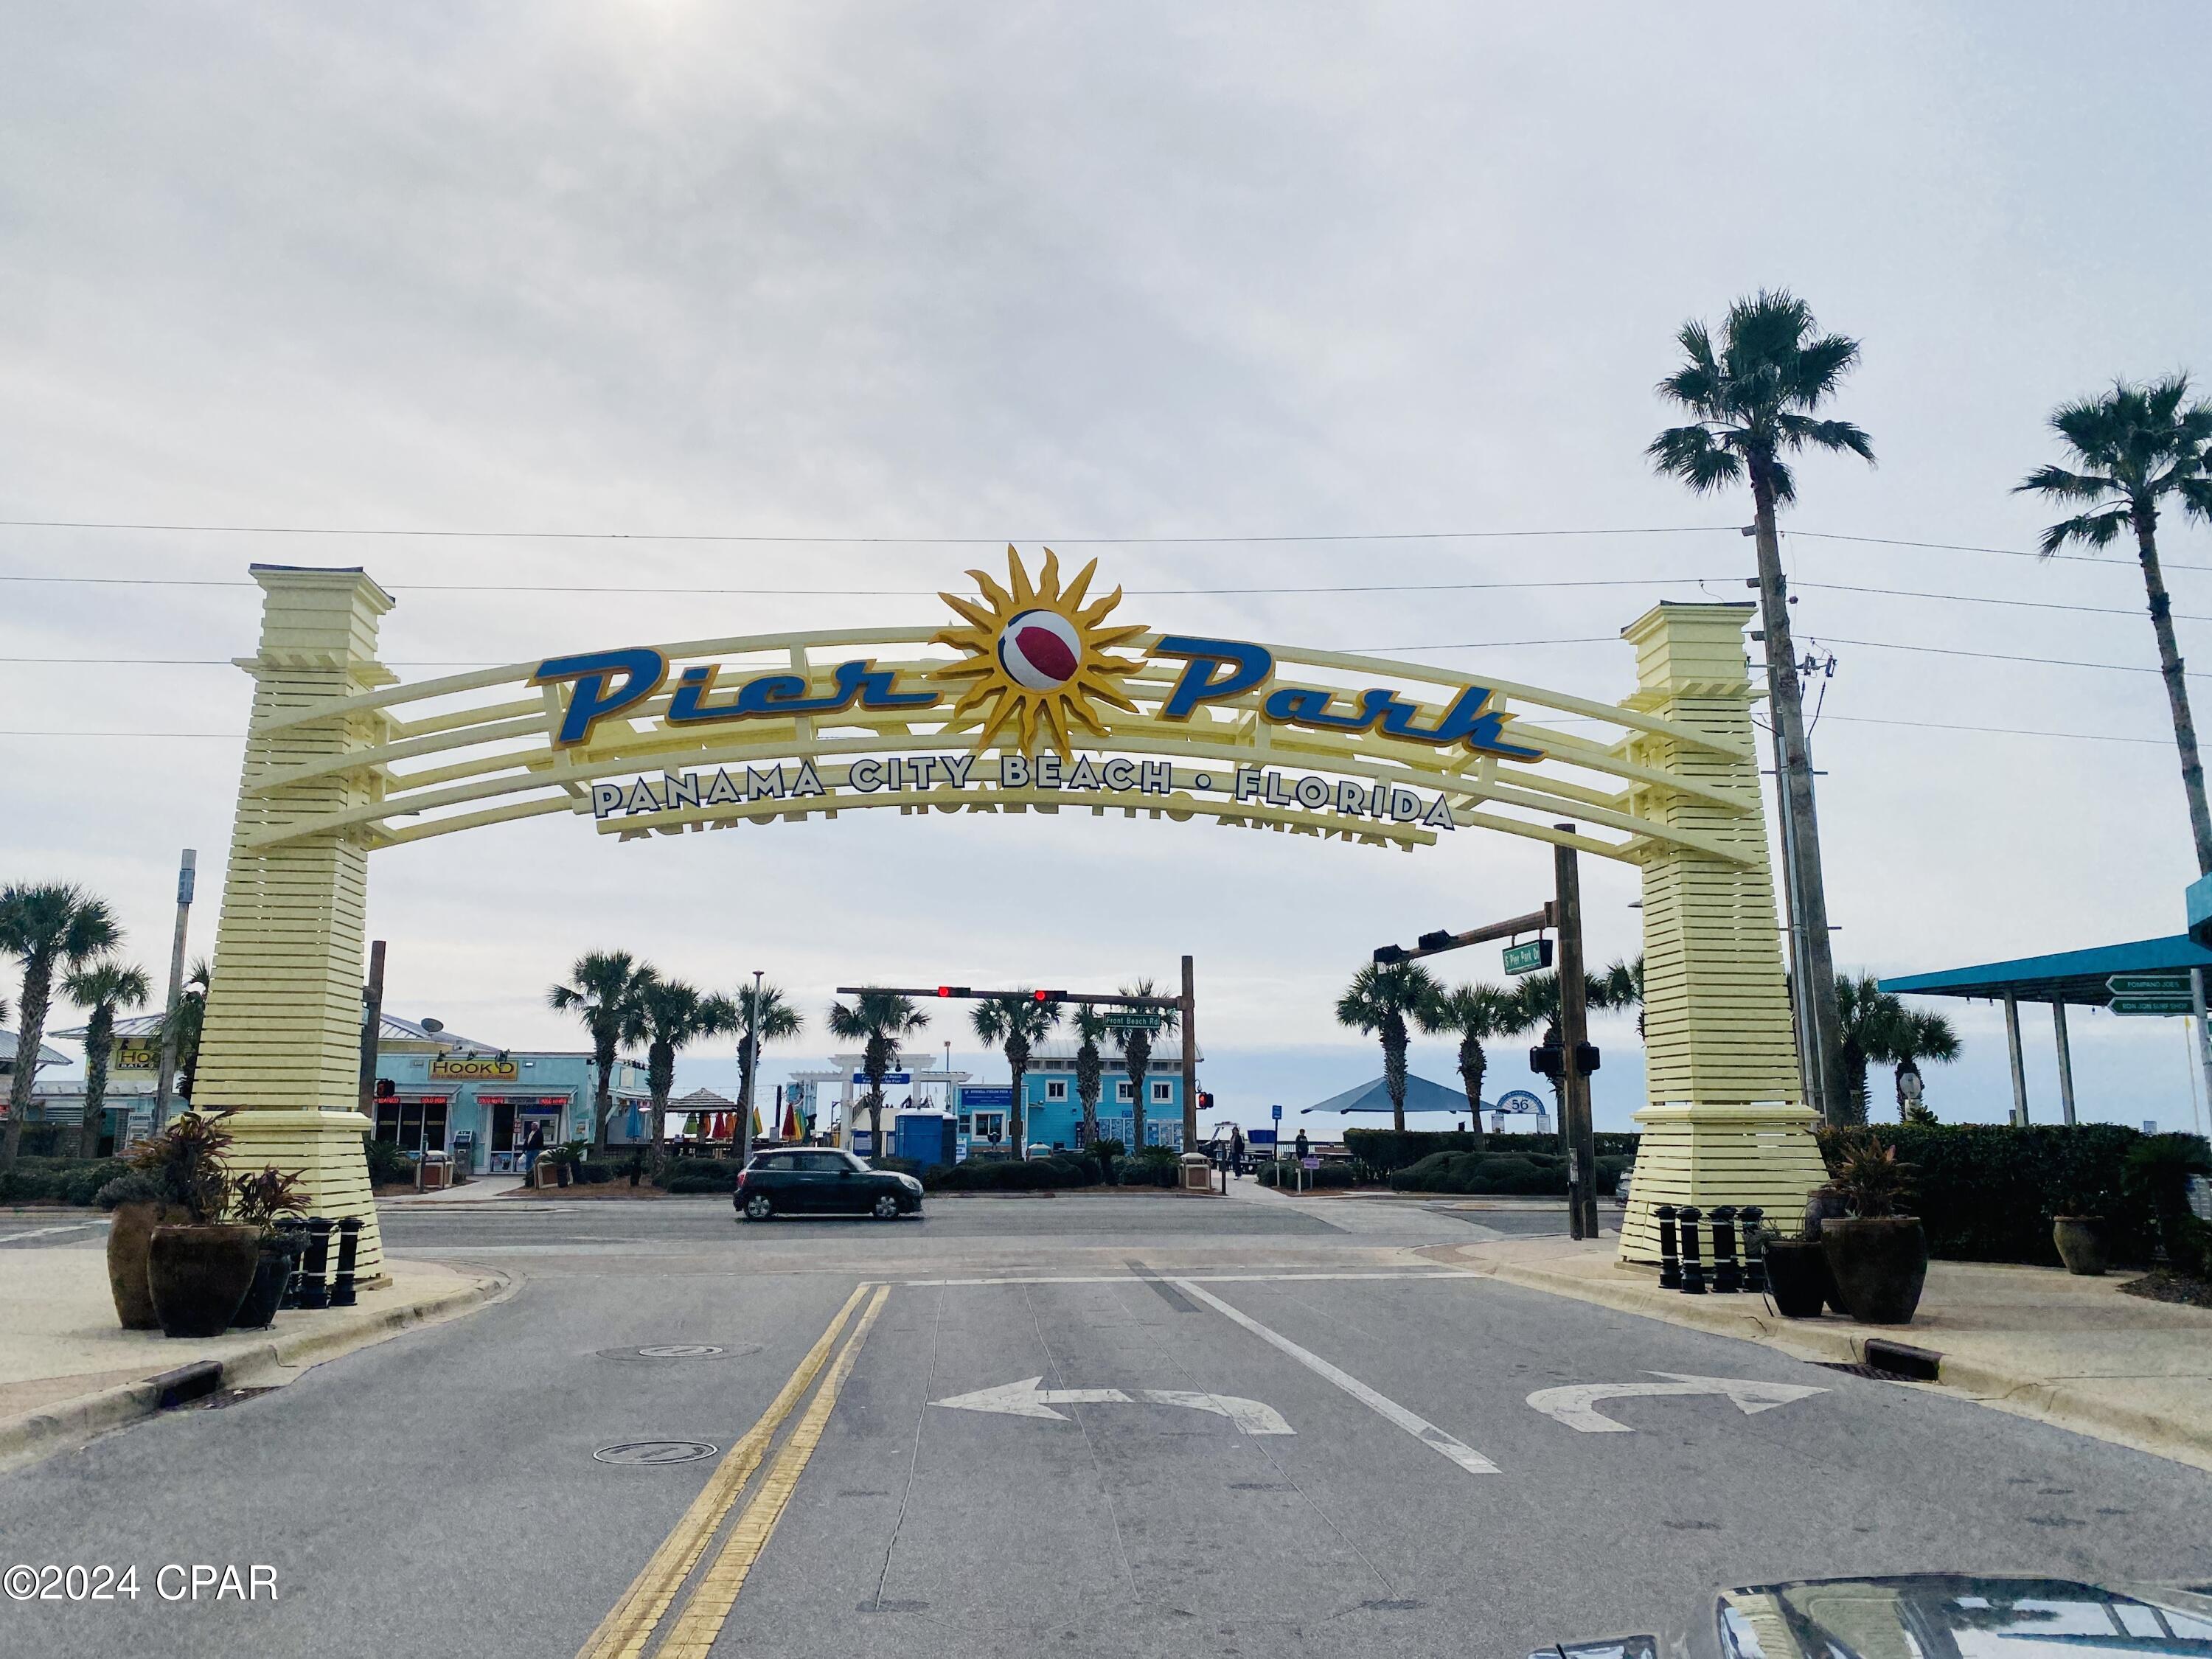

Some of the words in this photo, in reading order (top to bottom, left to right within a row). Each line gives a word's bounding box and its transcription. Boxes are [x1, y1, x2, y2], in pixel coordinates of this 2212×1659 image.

[524, 647, 945, 751] Pier
[1142, 634, 1549, 763] Park
[591, 759, 826, 819] PANAMA
[849, 754, 976, 793] CITY
[1002, 754, 1172, 794] BEACH
[1236, 768, 1457, 831] FLORIDA
[1505, 956, 1509, 967] S
[1510, 954, 1519, 966] Pier
[1521, 950, 1532, 963] Park
[1512, 1099, 1528, 1110] 56
